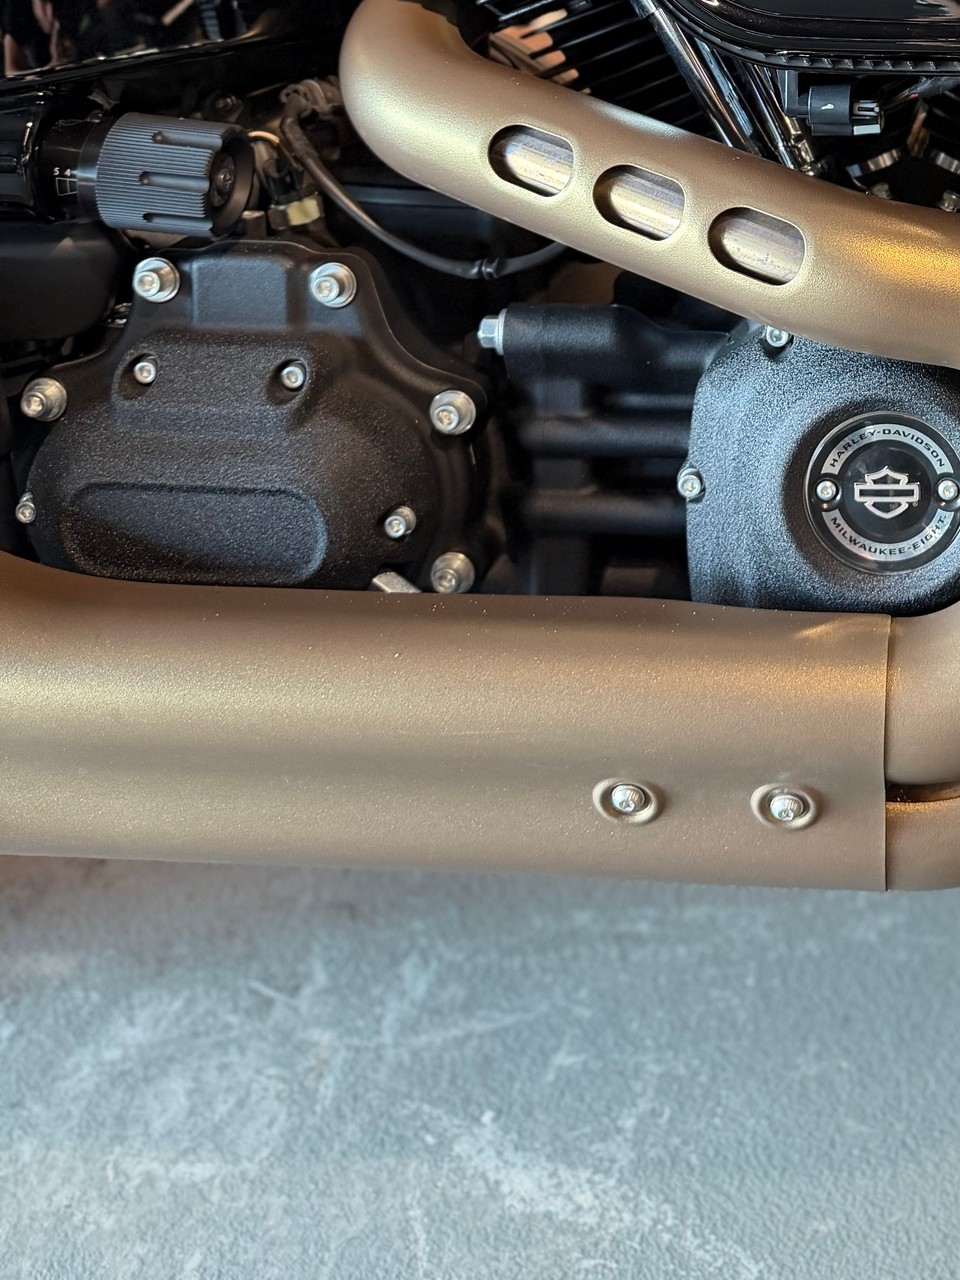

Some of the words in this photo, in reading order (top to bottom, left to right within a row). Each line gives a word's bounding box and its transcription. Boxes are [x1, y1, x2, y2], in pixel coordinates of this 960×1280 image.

[53, 167, 60, 176] 5
[829, 428, 946, 468] HARLEY-DAVIDSON
[830, 514, 947, 556] MILWAUKEE-EIGHT
